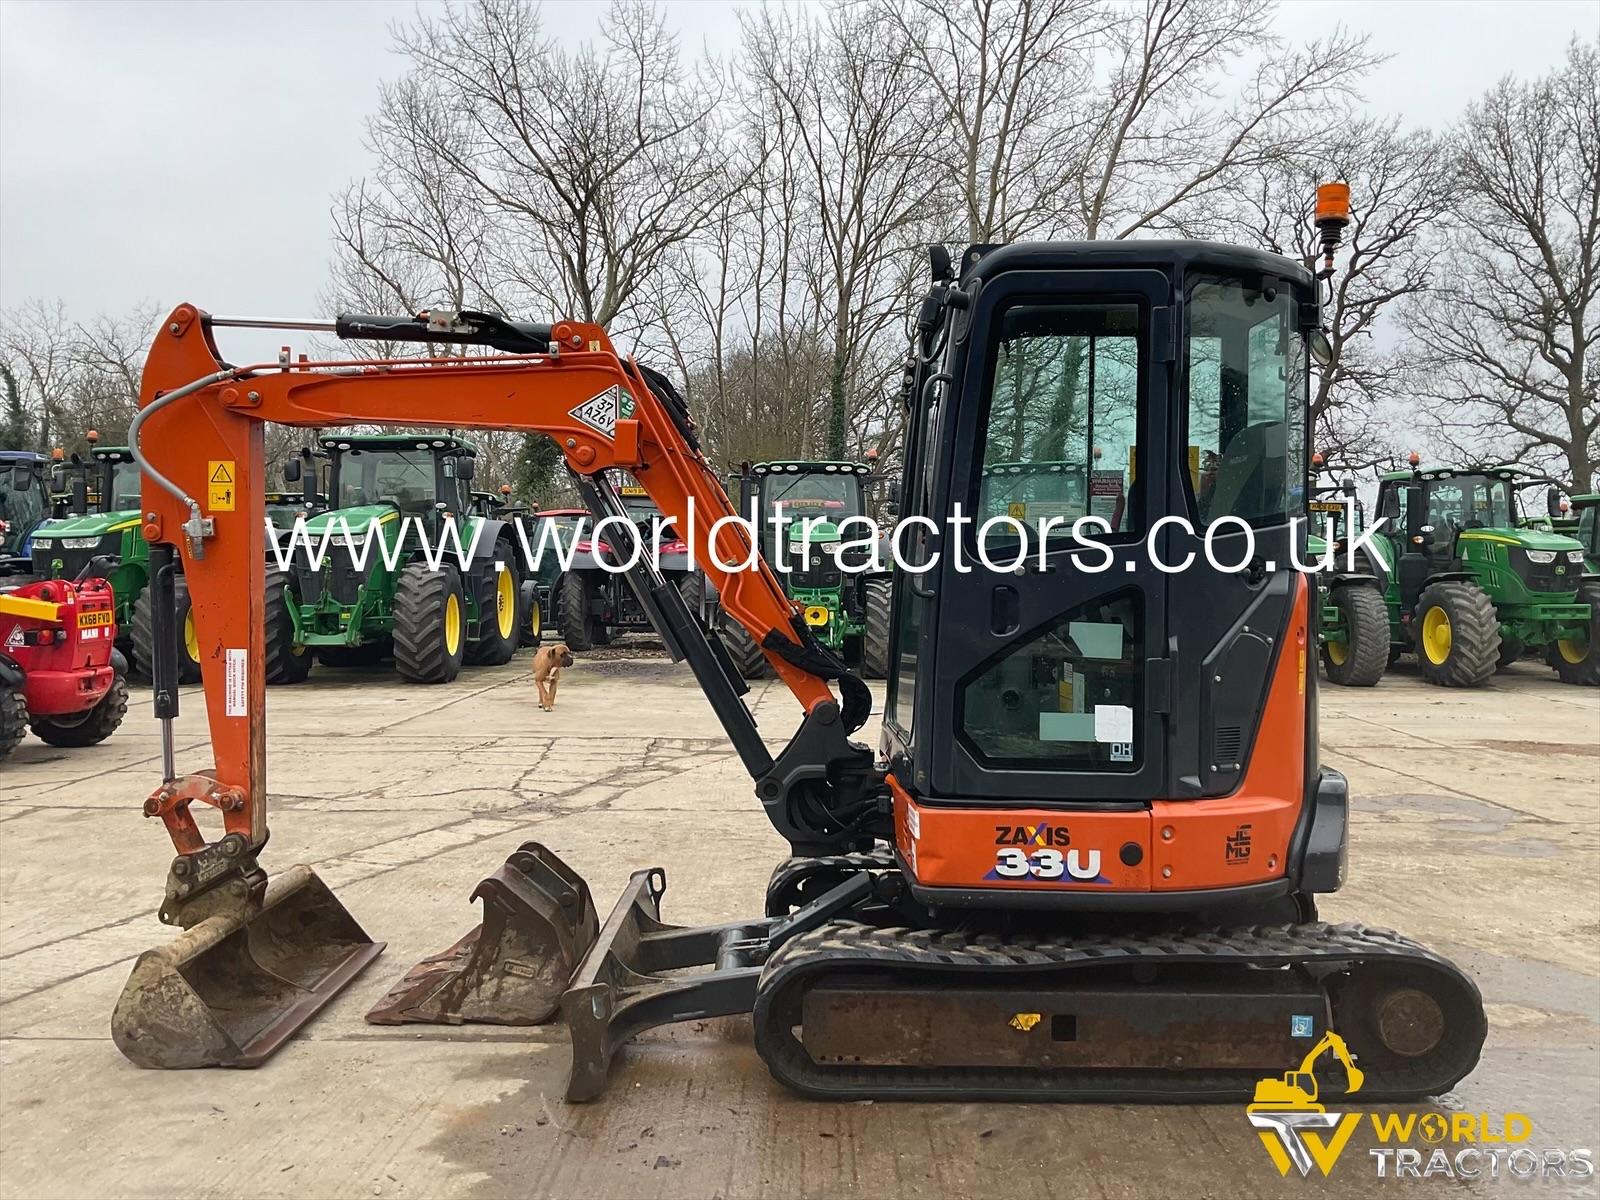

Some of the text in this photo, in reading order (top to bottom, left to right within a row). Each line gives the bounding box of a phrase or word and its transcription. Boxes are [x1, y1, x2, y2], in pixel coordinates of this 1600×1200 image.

[597, 398, 614, 413] 37
[626, 401, 635, 411] 5
[79, 614, 97, 626] KX68
[995, 823, 1071, 847] ZAXIS
[995, 847, 1101, 881] 33U
